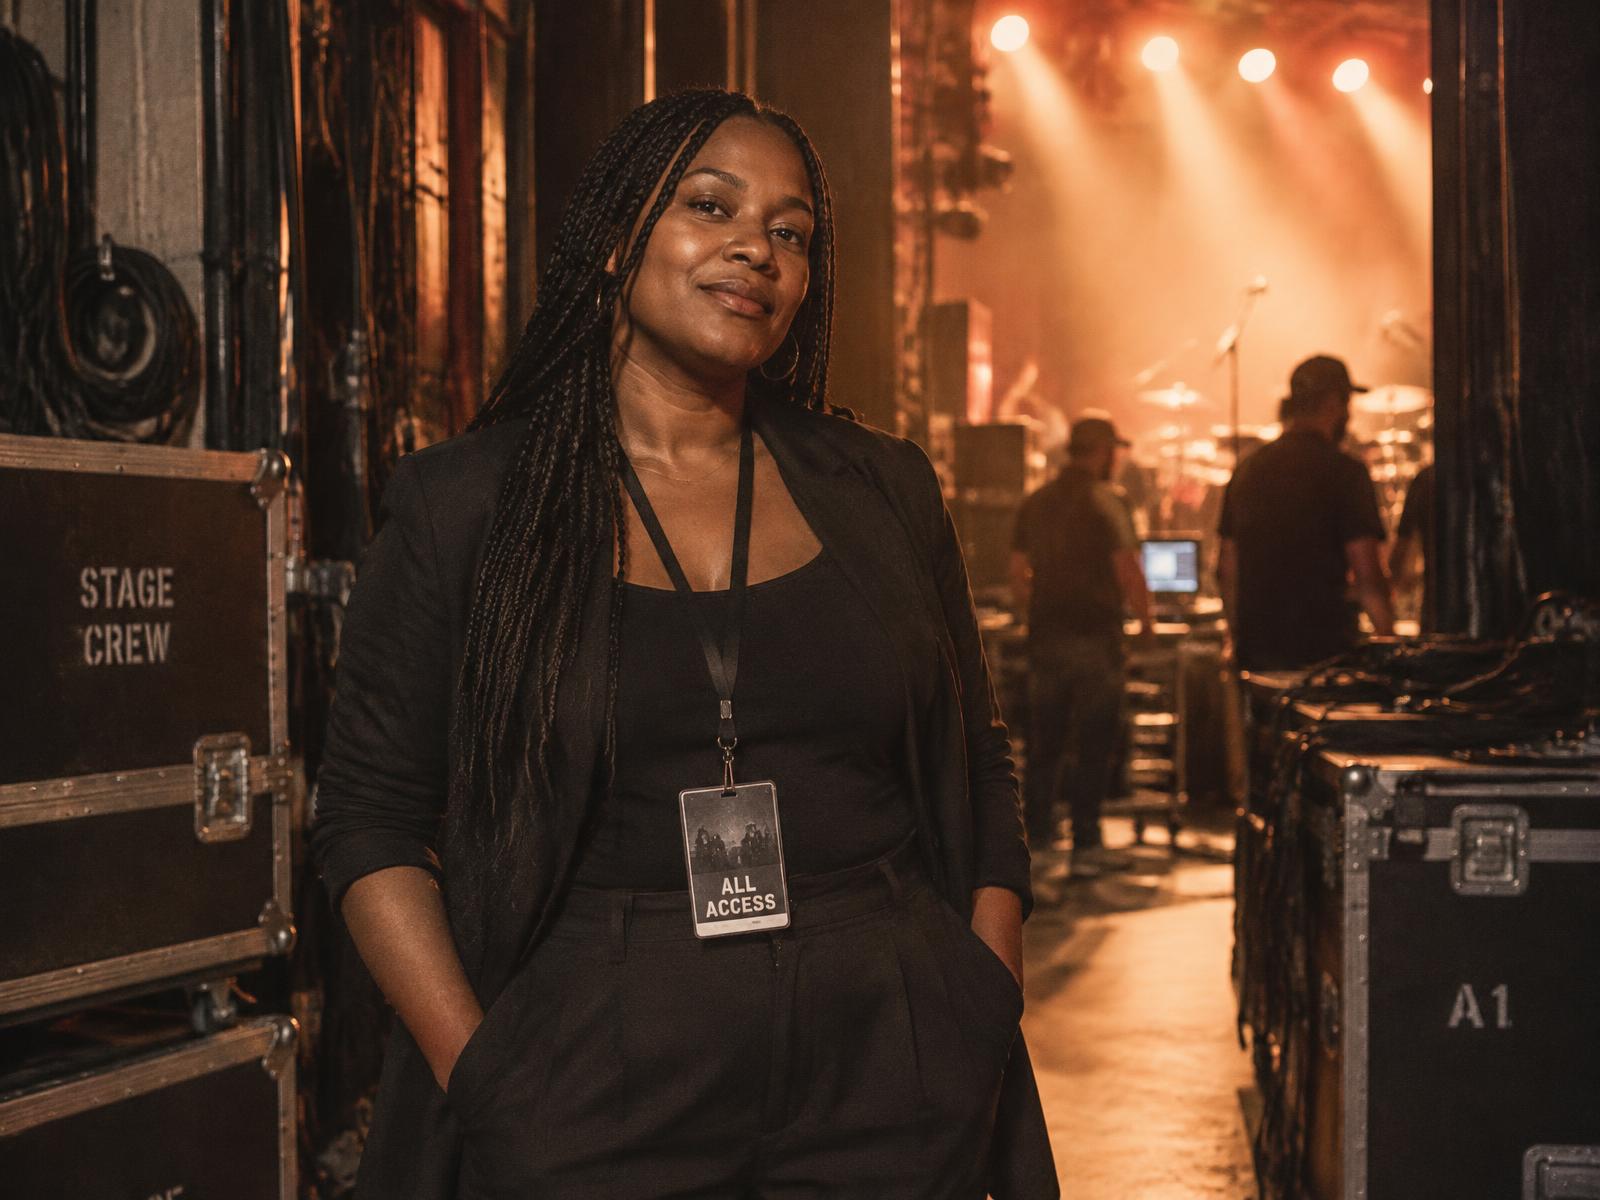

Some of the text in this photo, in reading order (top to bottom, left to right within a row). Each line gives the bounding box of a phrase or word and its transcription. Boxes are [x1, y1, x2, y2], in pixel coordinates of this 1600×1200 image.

[81, 567, 175, 608] STAGE
[84, 622, 171, 665] CREW
[706, 893, 776, 918] ACCESS
[721, 875, 757, 896] ALL
[1447, 984, 1512, 1029] A1
